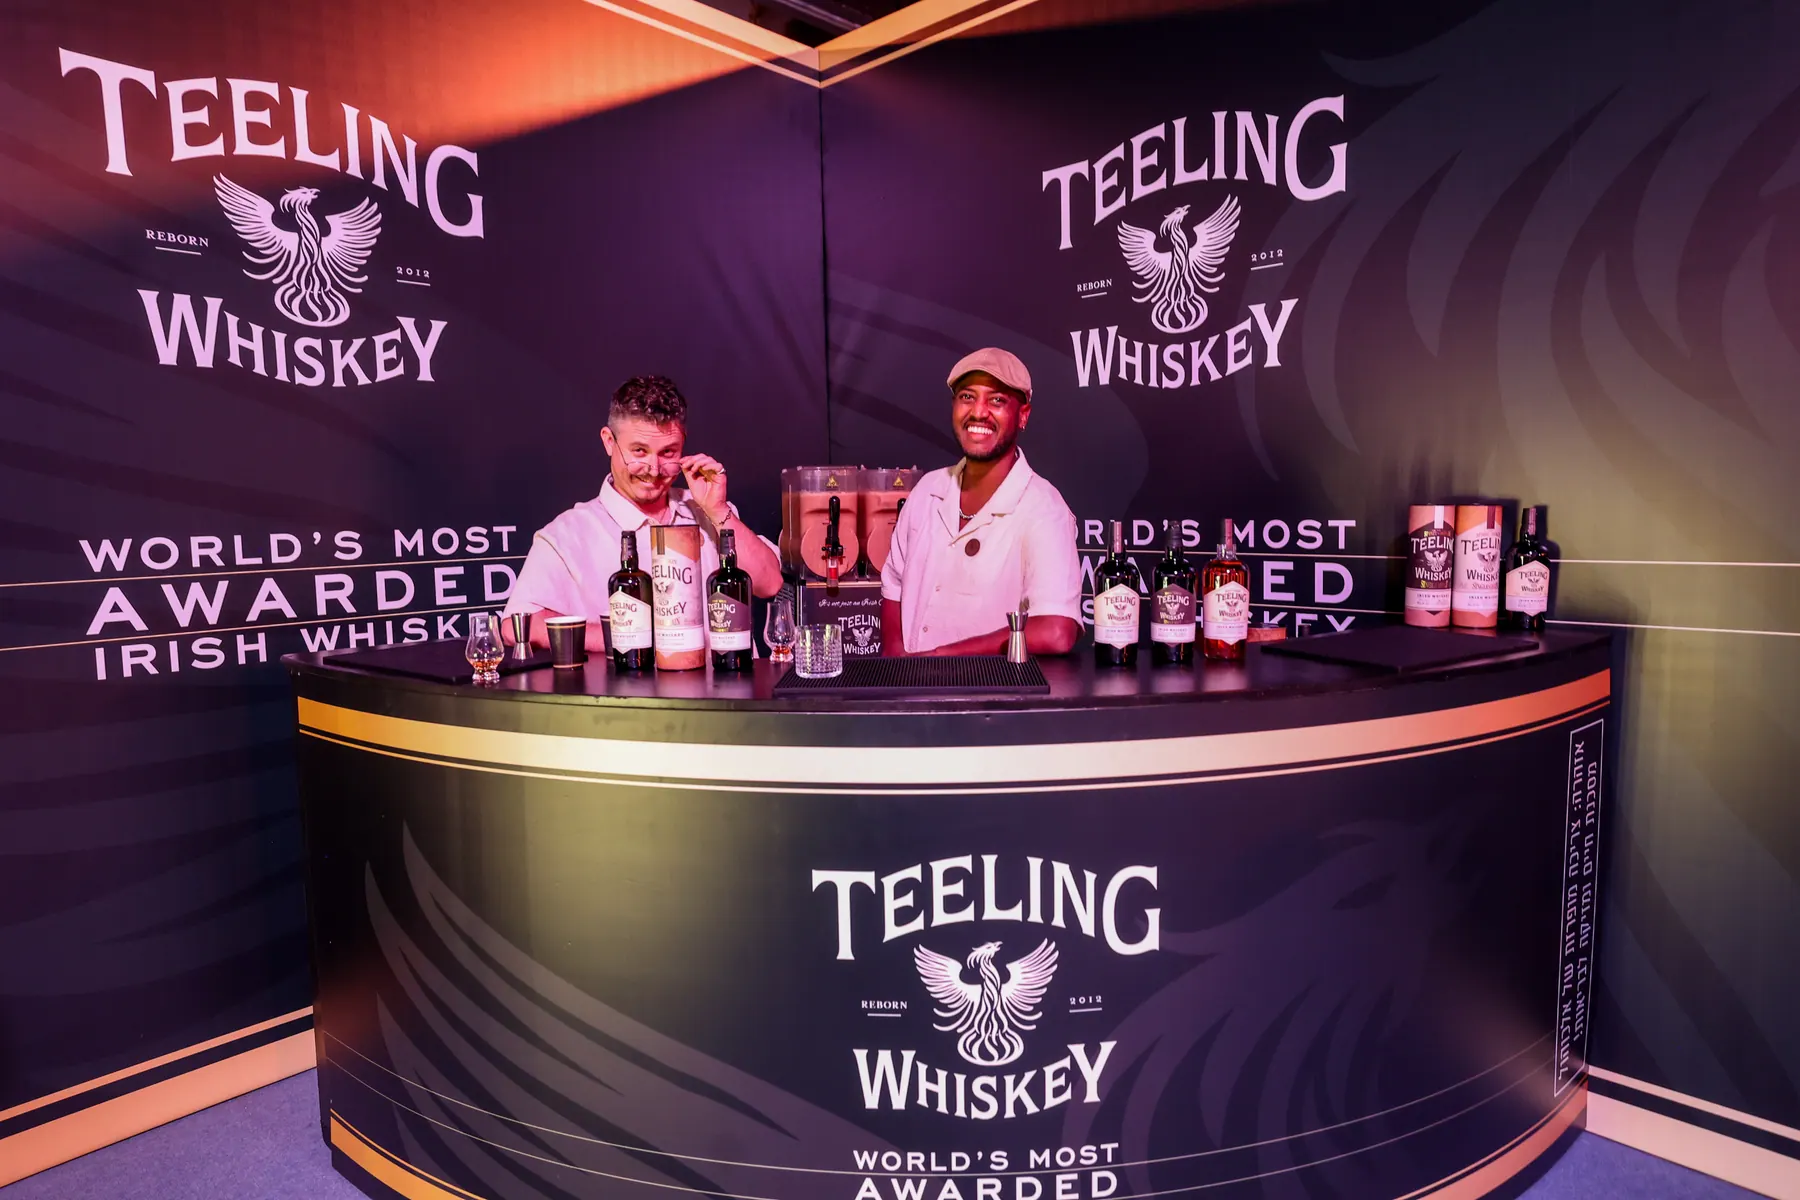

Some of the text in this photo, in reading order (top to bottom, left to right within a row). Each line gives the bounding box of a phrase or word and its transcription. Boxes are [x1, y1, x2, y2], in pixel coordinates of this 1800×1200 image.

[58, 47, 484, 239] TEELING
[1042, 94, 1348, 250] TEELING
[146, 229, 209, 248] REBORN
[1251, 249, 1284, 262] 2012
[396, 266, 430, 278] 2012
[1076, 278, 1112, 292] REBORN
[137, 289, 447, 388] WHISKEY
[1070, 298, 1299, 389] WHISKEY
[79, 525, 517, 573] WORLD'S MOST
[1411, 536, 1455, 555] TEELIN
[1519, 571, 1548, 580] TEELING
[86, 563, 517, 636] AWARDED
[1104, 595, 1136, 607] TEELING
[1157, 594, 1190, 606] TEELING
[1216, 591, 1247, 603] TEELING
[838, 614, 881, 632] TEELIN
[1160, 612, 1185, 621] WHISKEY
[95, 611, 502, 681] IRISH WHISKE
[843, 642, 881, 655] WHISKEY
[1585, 761, 1597, 827] מסכנת
[1568, 819, 1581, 877] צריכה
[1583, 833, 1594, 876] חיים
[812, 854, 1161, 961] TEELING
[1562, 963, 1574, 996] של
[861, 1000, 908, 1010] REBORN
[1069, 995, 1102, 1005] 2012
[853, 1041, 1118, 1120] WHISKEY
[853, 1142, 1119, 1172] WORLD'S MOST
[854, 1171, 1118, 1200] AWARDED
